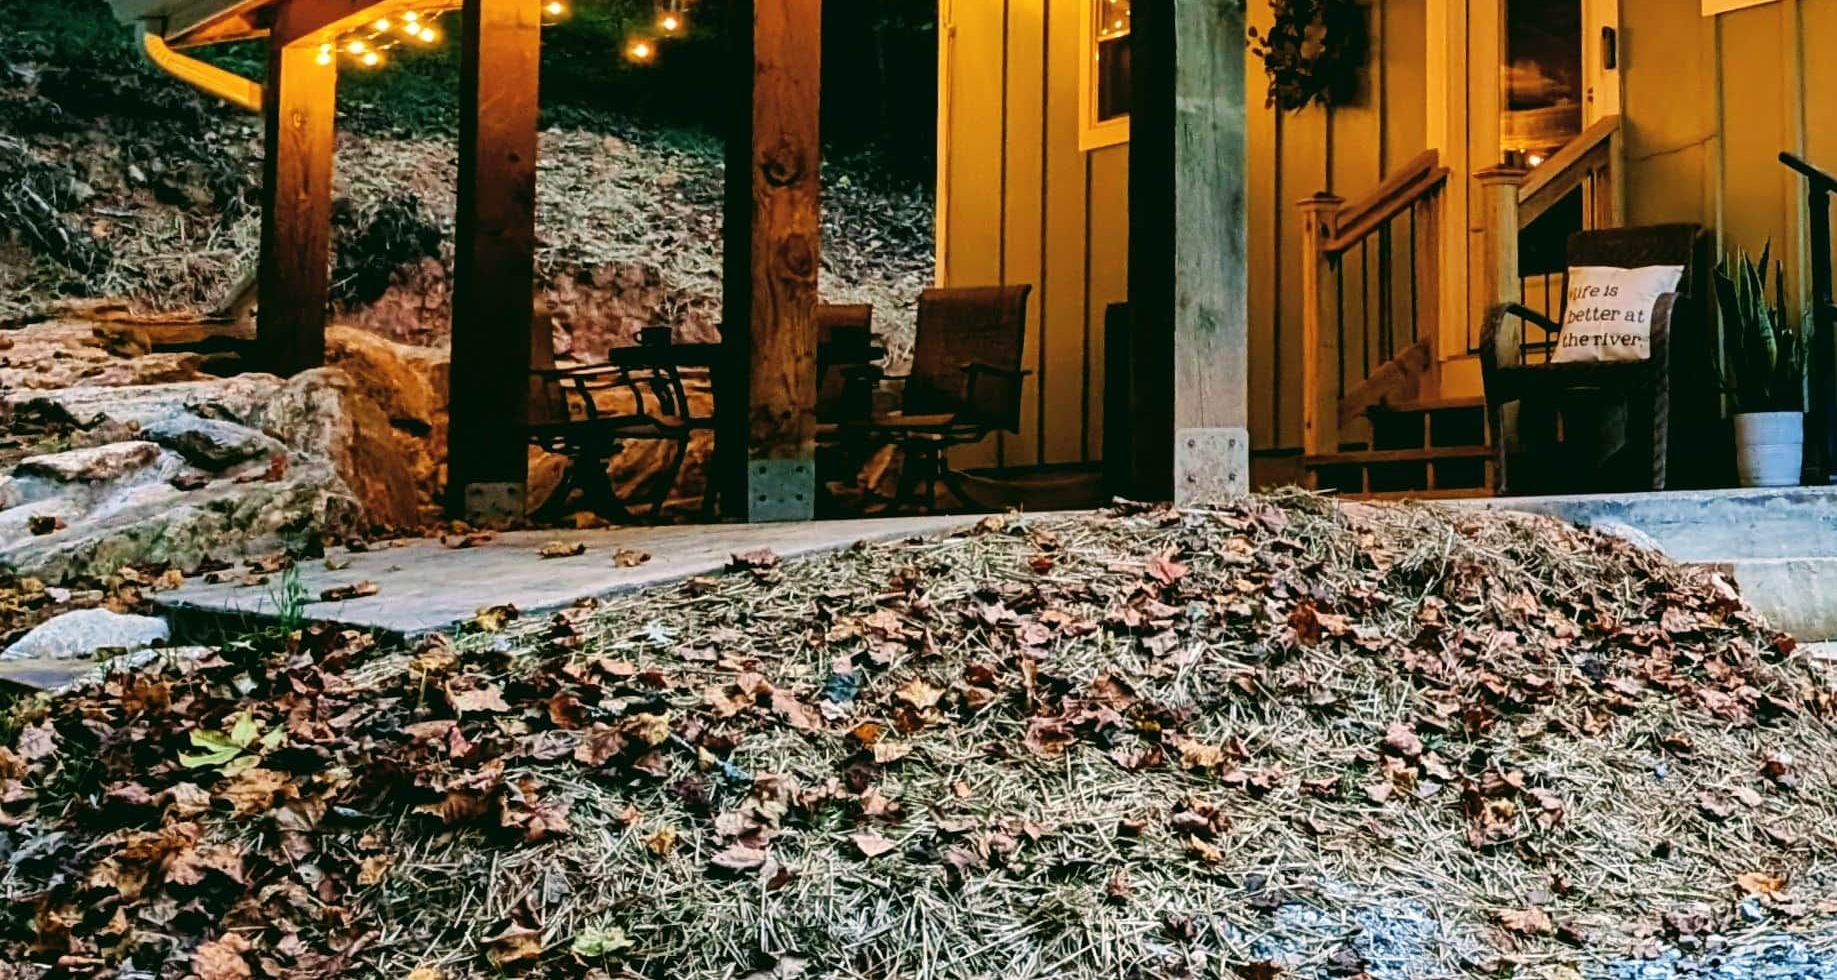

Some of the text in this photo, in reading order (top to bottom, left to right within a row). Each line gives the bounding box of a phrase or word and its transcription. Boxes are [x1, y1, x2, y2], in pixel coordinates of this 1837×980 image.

[1603, 284, 1619, 297] is
[1567, 307, 1645, 324] better at
[1562, 332, 1643, 348] the river.
